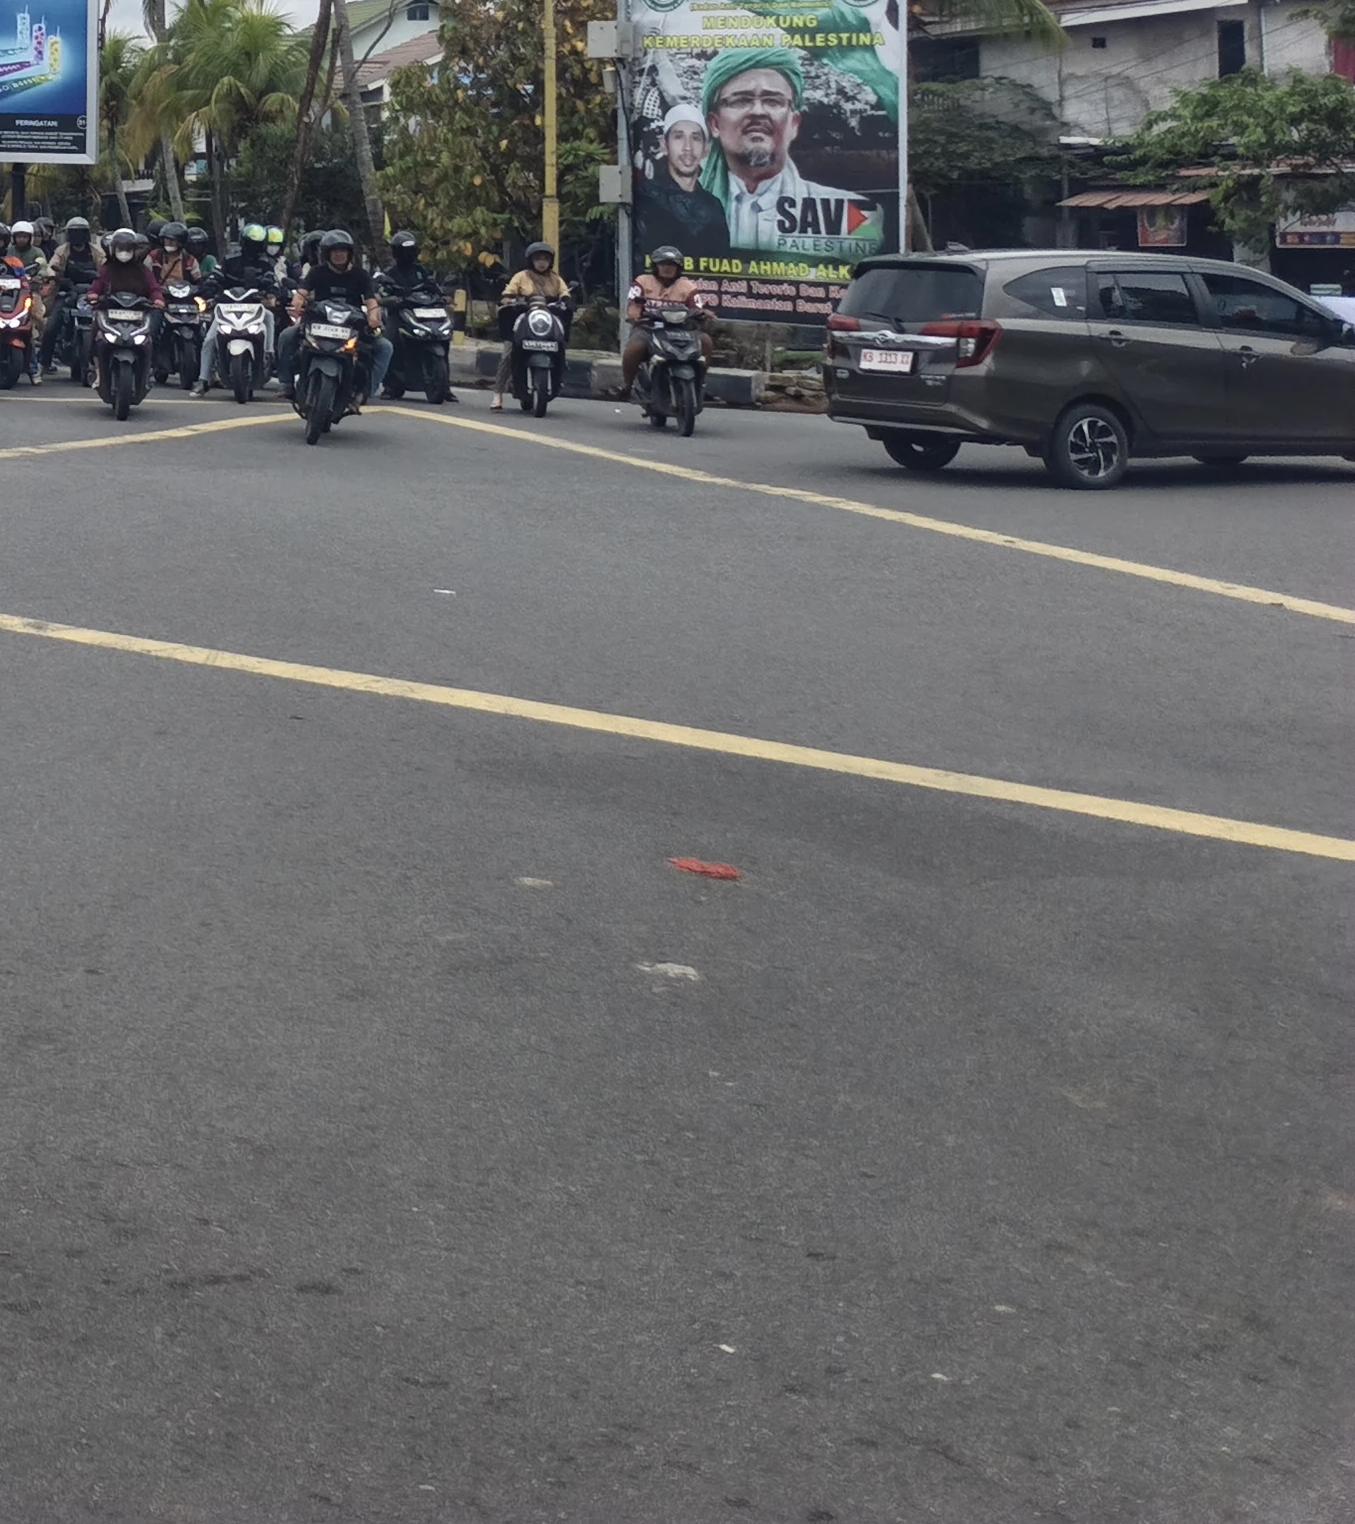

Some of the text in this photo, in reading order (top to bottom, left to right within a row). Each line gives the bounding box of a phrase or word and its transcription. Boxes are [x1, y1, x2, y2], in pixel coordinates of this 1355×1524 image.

[702, 14, 818, 30] MENDUKUNG
[643, 32, 886, 50] KEMERDEKAAN PALESTINA
[777, 239, 878, 254] PALESTINE
[699, 258, 742, 273] FUAD
[748, 260, 810, 277] AHMAD
[721, 279, 747, 293] Anti
[749, 282, 797, 296] Teroris
[799, 284, 825, 298] Dan
[721, 295, 793, 312] Kalimantan
[796, 300, 833, 315] Barat
